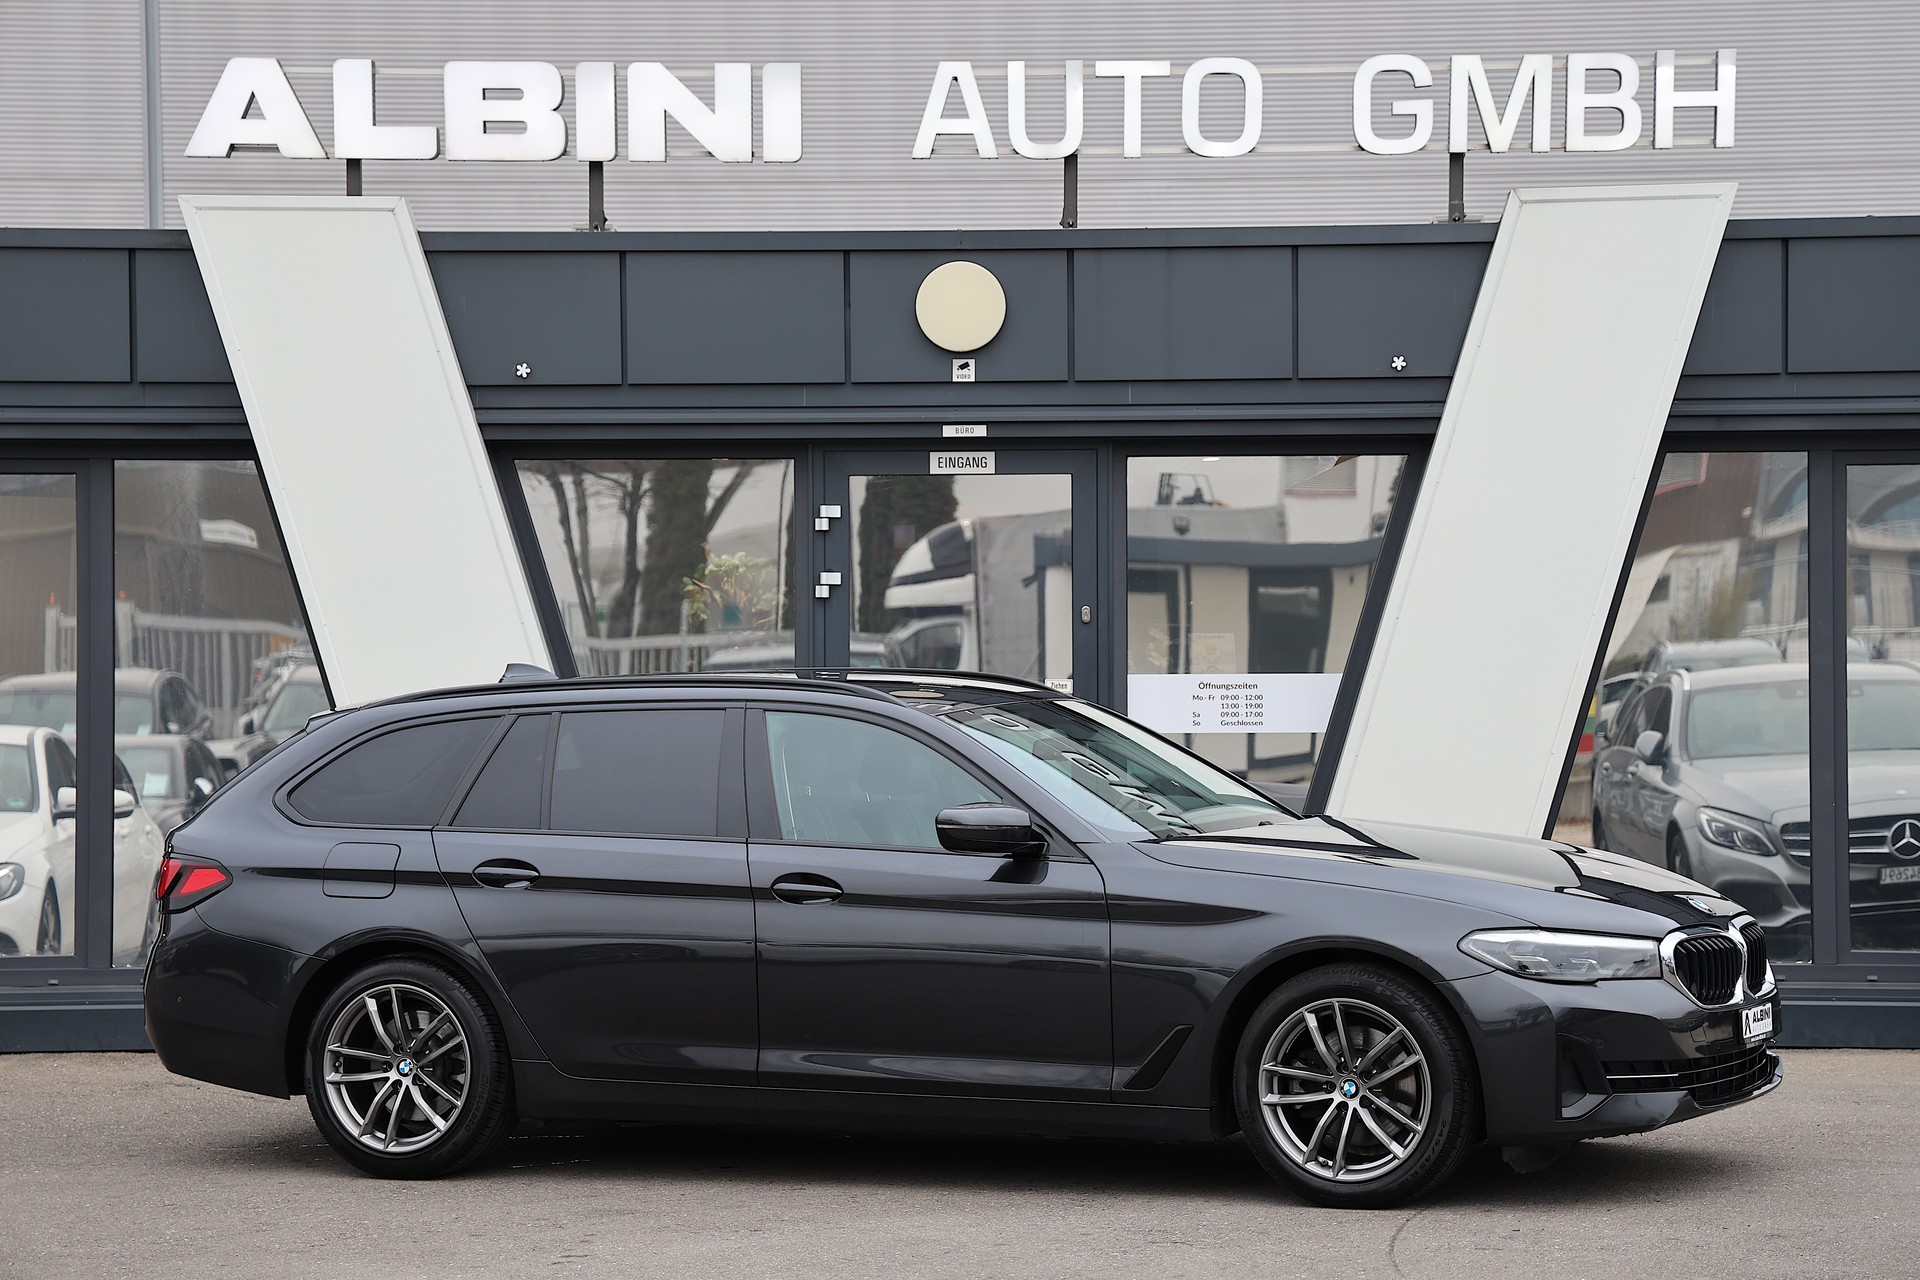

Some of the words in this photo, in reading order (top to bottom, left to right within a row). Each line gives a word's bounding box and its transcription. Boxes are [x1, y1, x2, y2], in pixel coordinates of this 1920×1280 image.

[184, 57, 803, 163] ALBINI
[911, 56, 1263, 159] AUTO
[1352, 48, 1738, 155] GMBH
[955, 426, 975, 434] BÜRO
[937, 456, 988, 468] EINGANG
[1050, 682, 1068, 690] Ziehen
[1198, 681, 1258, 691] Öffnungszeiten
[1220, 719, 1264, 727] Geschlossen
[1752, 1006, 1771, 1024] ALBINI
